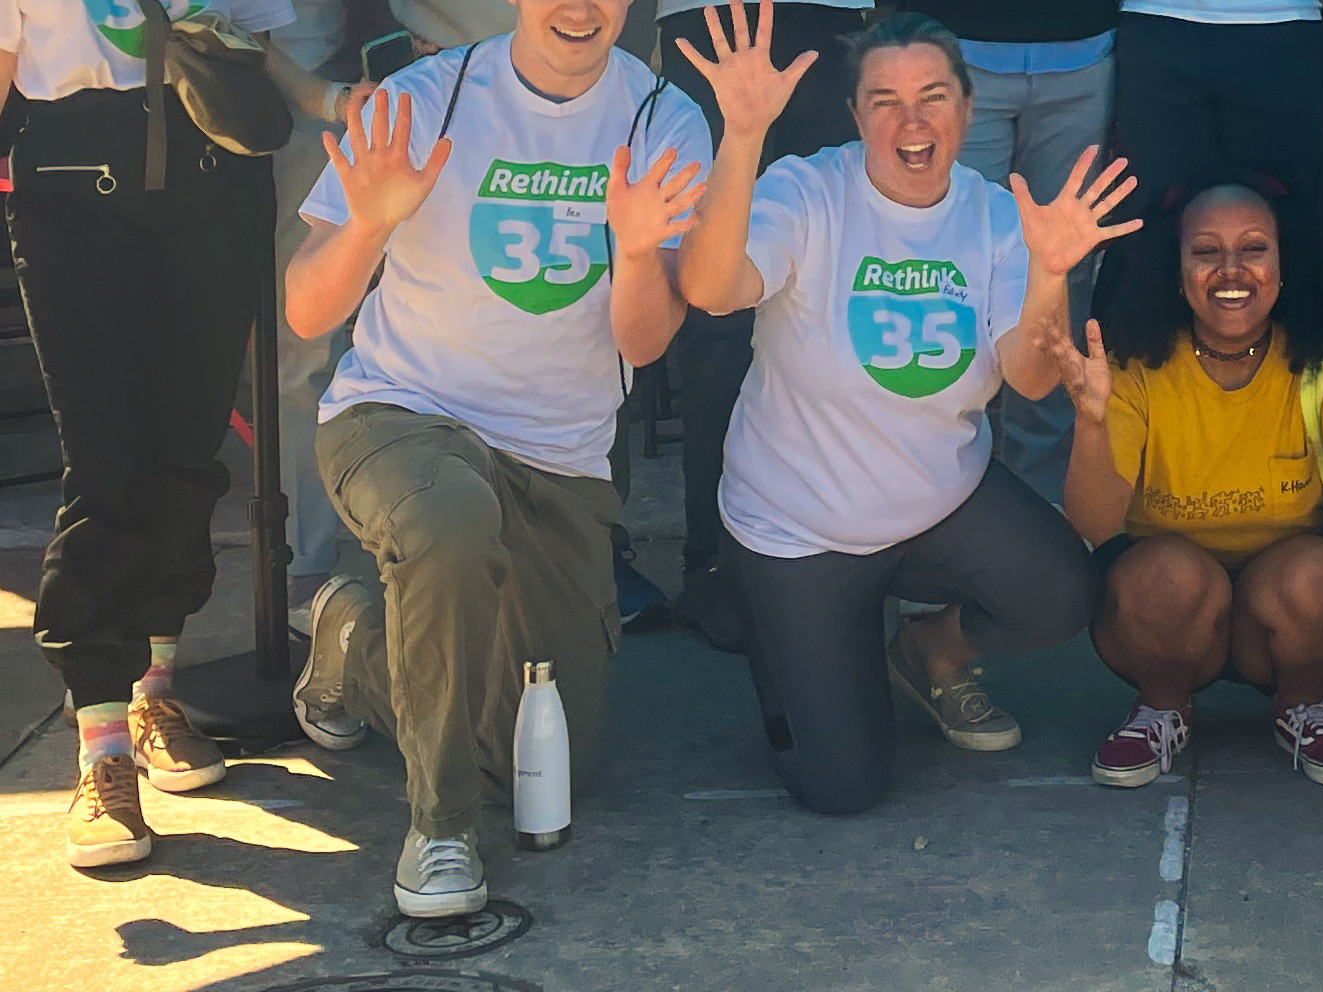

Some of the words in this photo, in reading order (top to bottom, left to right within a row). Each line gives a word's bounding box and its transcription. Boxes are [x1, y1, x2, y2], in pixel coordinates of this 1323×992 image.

[488, 168, 607, 197] Rethink
[490, 219, 591, 285] 35
[863, 263, 957, 291] Rethink
[869, 309, 962, 369] 35
